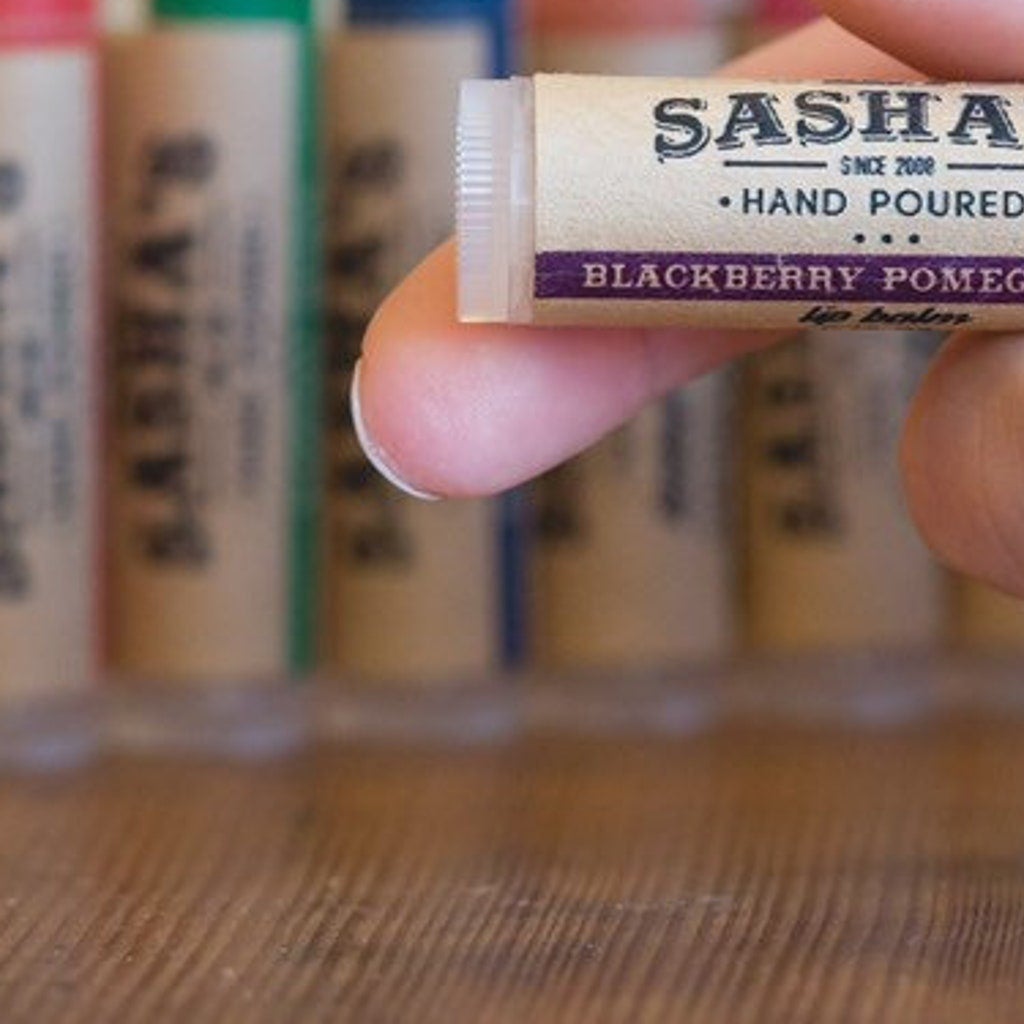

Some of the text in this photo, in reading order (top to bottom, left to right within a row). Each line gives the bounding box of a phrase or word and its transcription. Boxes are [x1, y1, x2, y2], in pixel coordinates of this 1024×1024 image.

[840, 155, 936, 176] SINCE 2008
[742, 188, 847, 216] HAND
[583, 263, 865, 292] BLACKBERRY
[798, 305, 972, 326] lip balm
